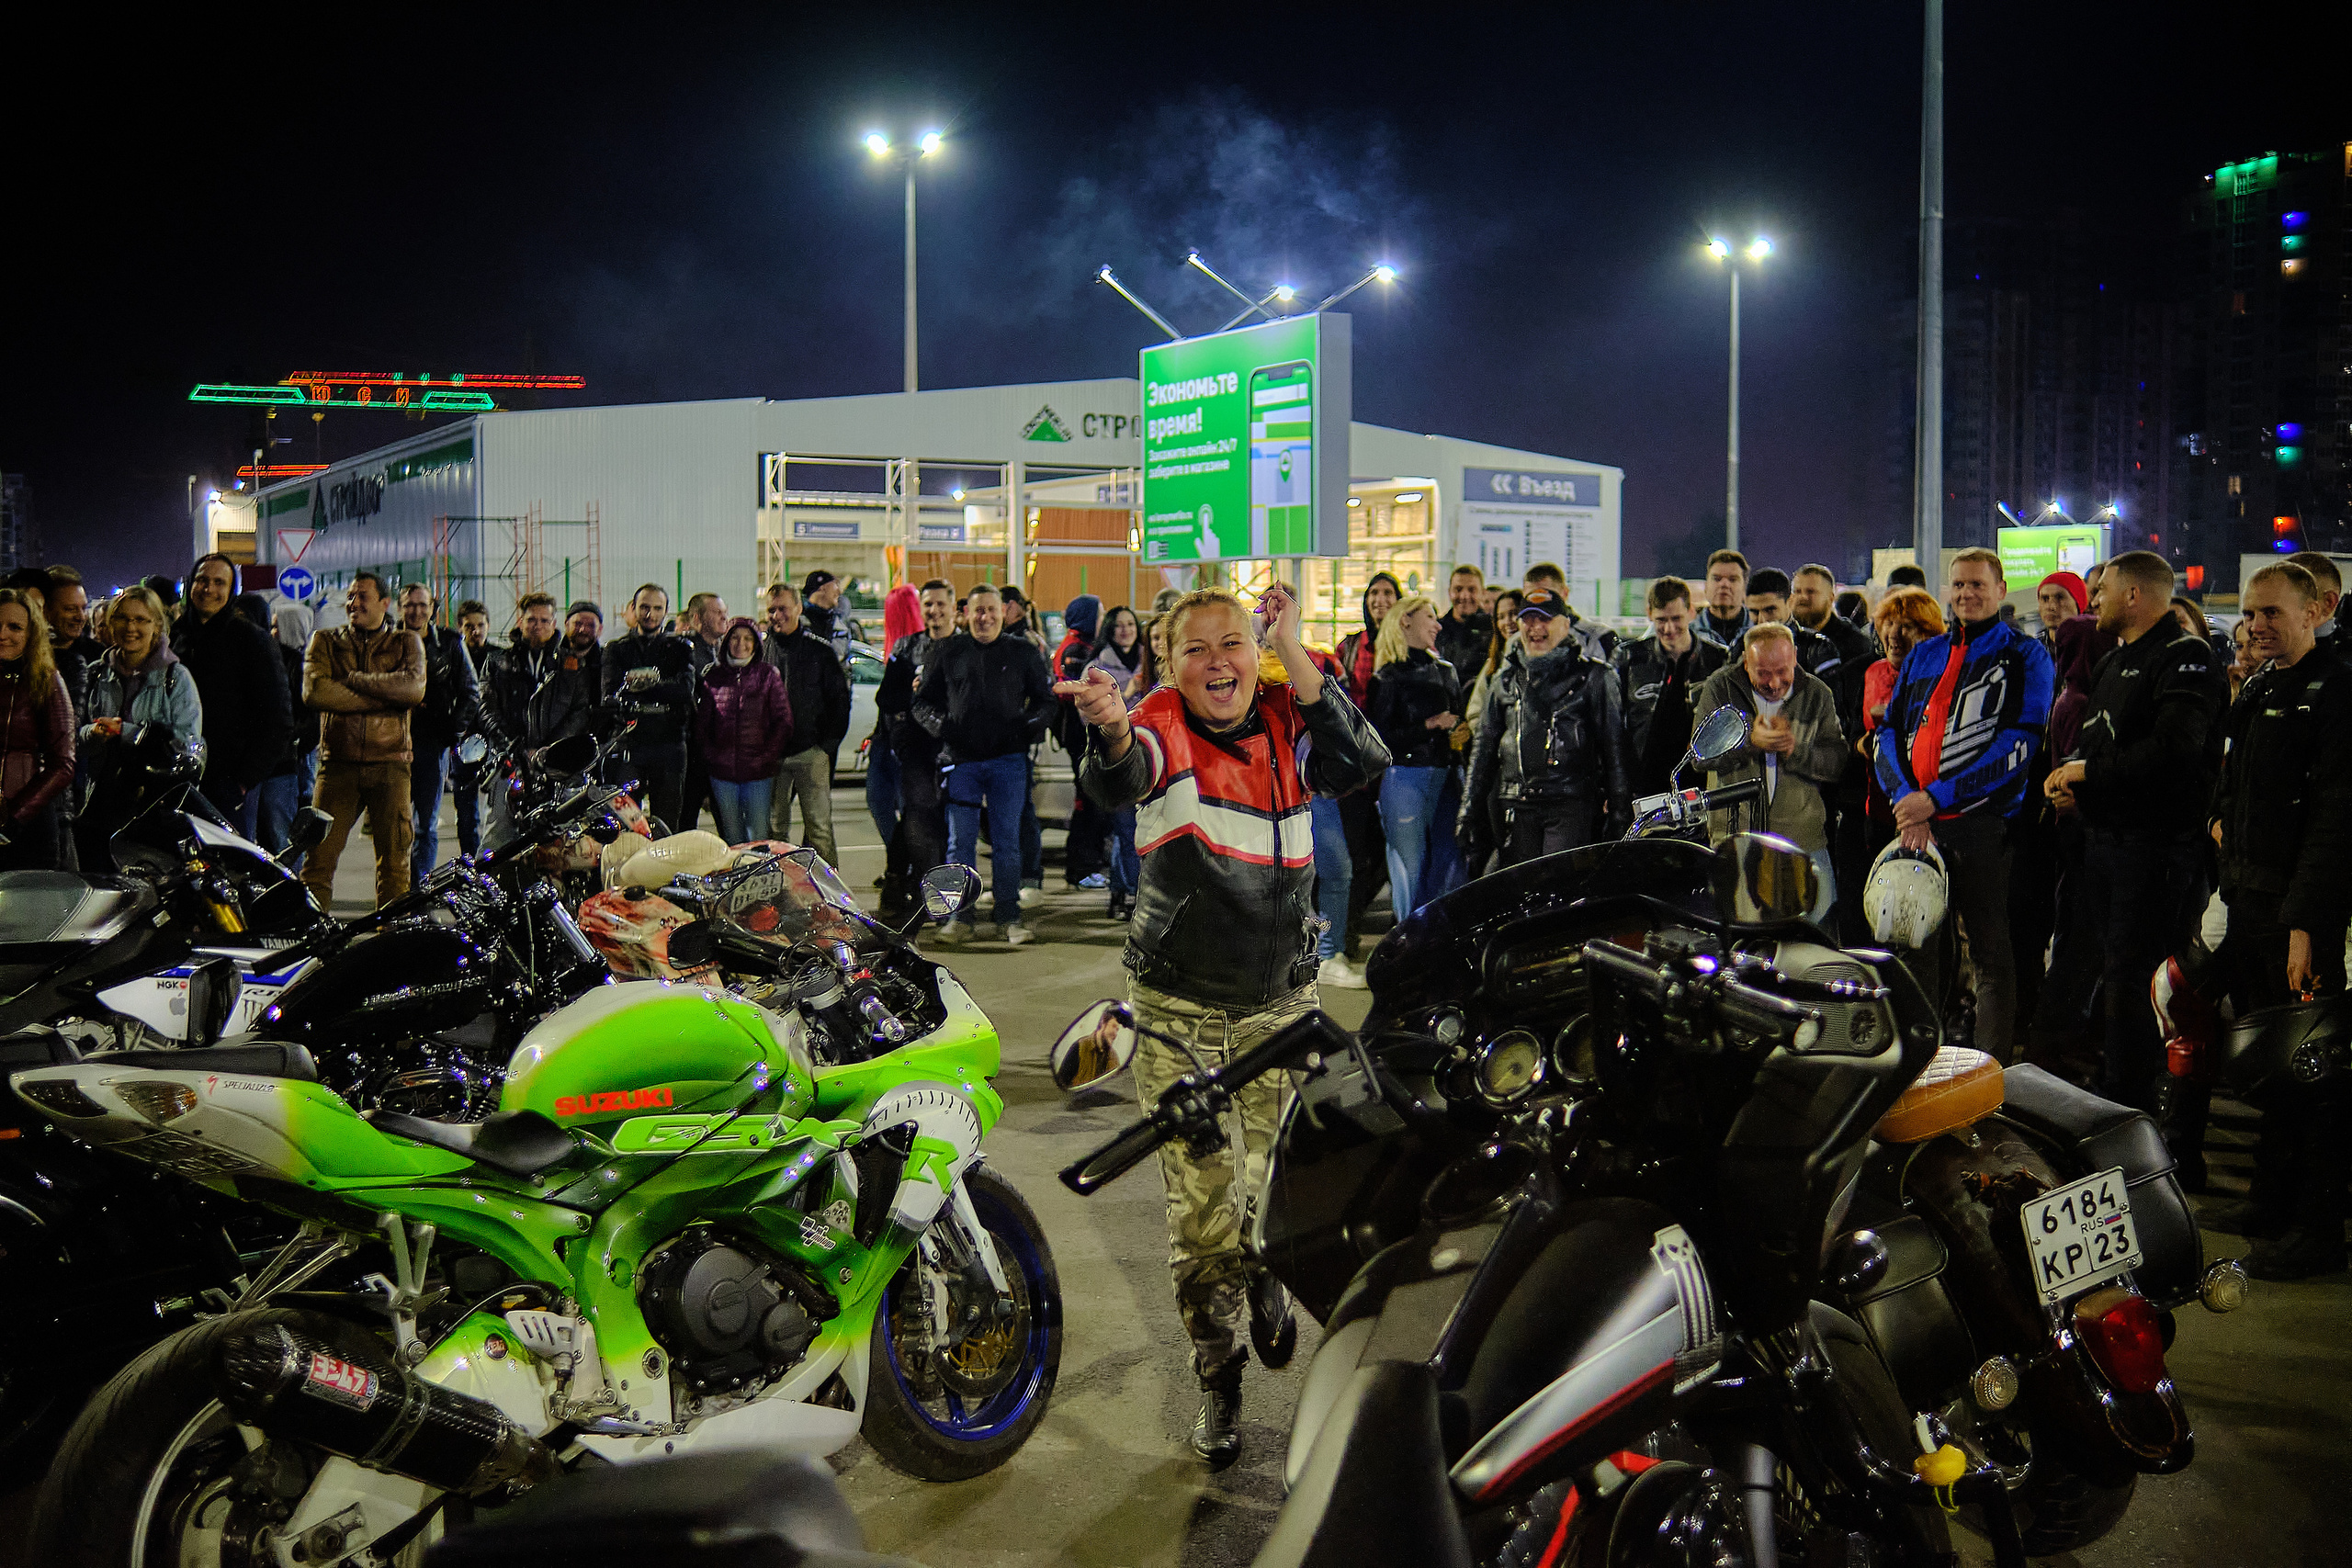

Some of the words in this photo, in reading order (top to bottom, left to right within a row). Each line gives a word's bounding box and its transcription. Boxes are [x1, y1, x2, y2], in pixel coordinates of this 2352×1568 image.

[1148, 372, 1238, 407] Экономьте
[1148, 407, 1203, 444] время!
[1217, 437, 1238, 454] 24/7
[1519, 475, 1577, 502] Въезд
[156, 980, 179, 989] NGK
[555, 1088, 673, 1117] SUZUKI
[900, 1135, 959, 1194] R
[2041, 1181, 2116, 1234] 6184
[2080, 1216, 2104, 1234] RUS
[2094, 1224, 2130, 1263] 23
[313, 1354, 367, 1393] ヨシムラ
